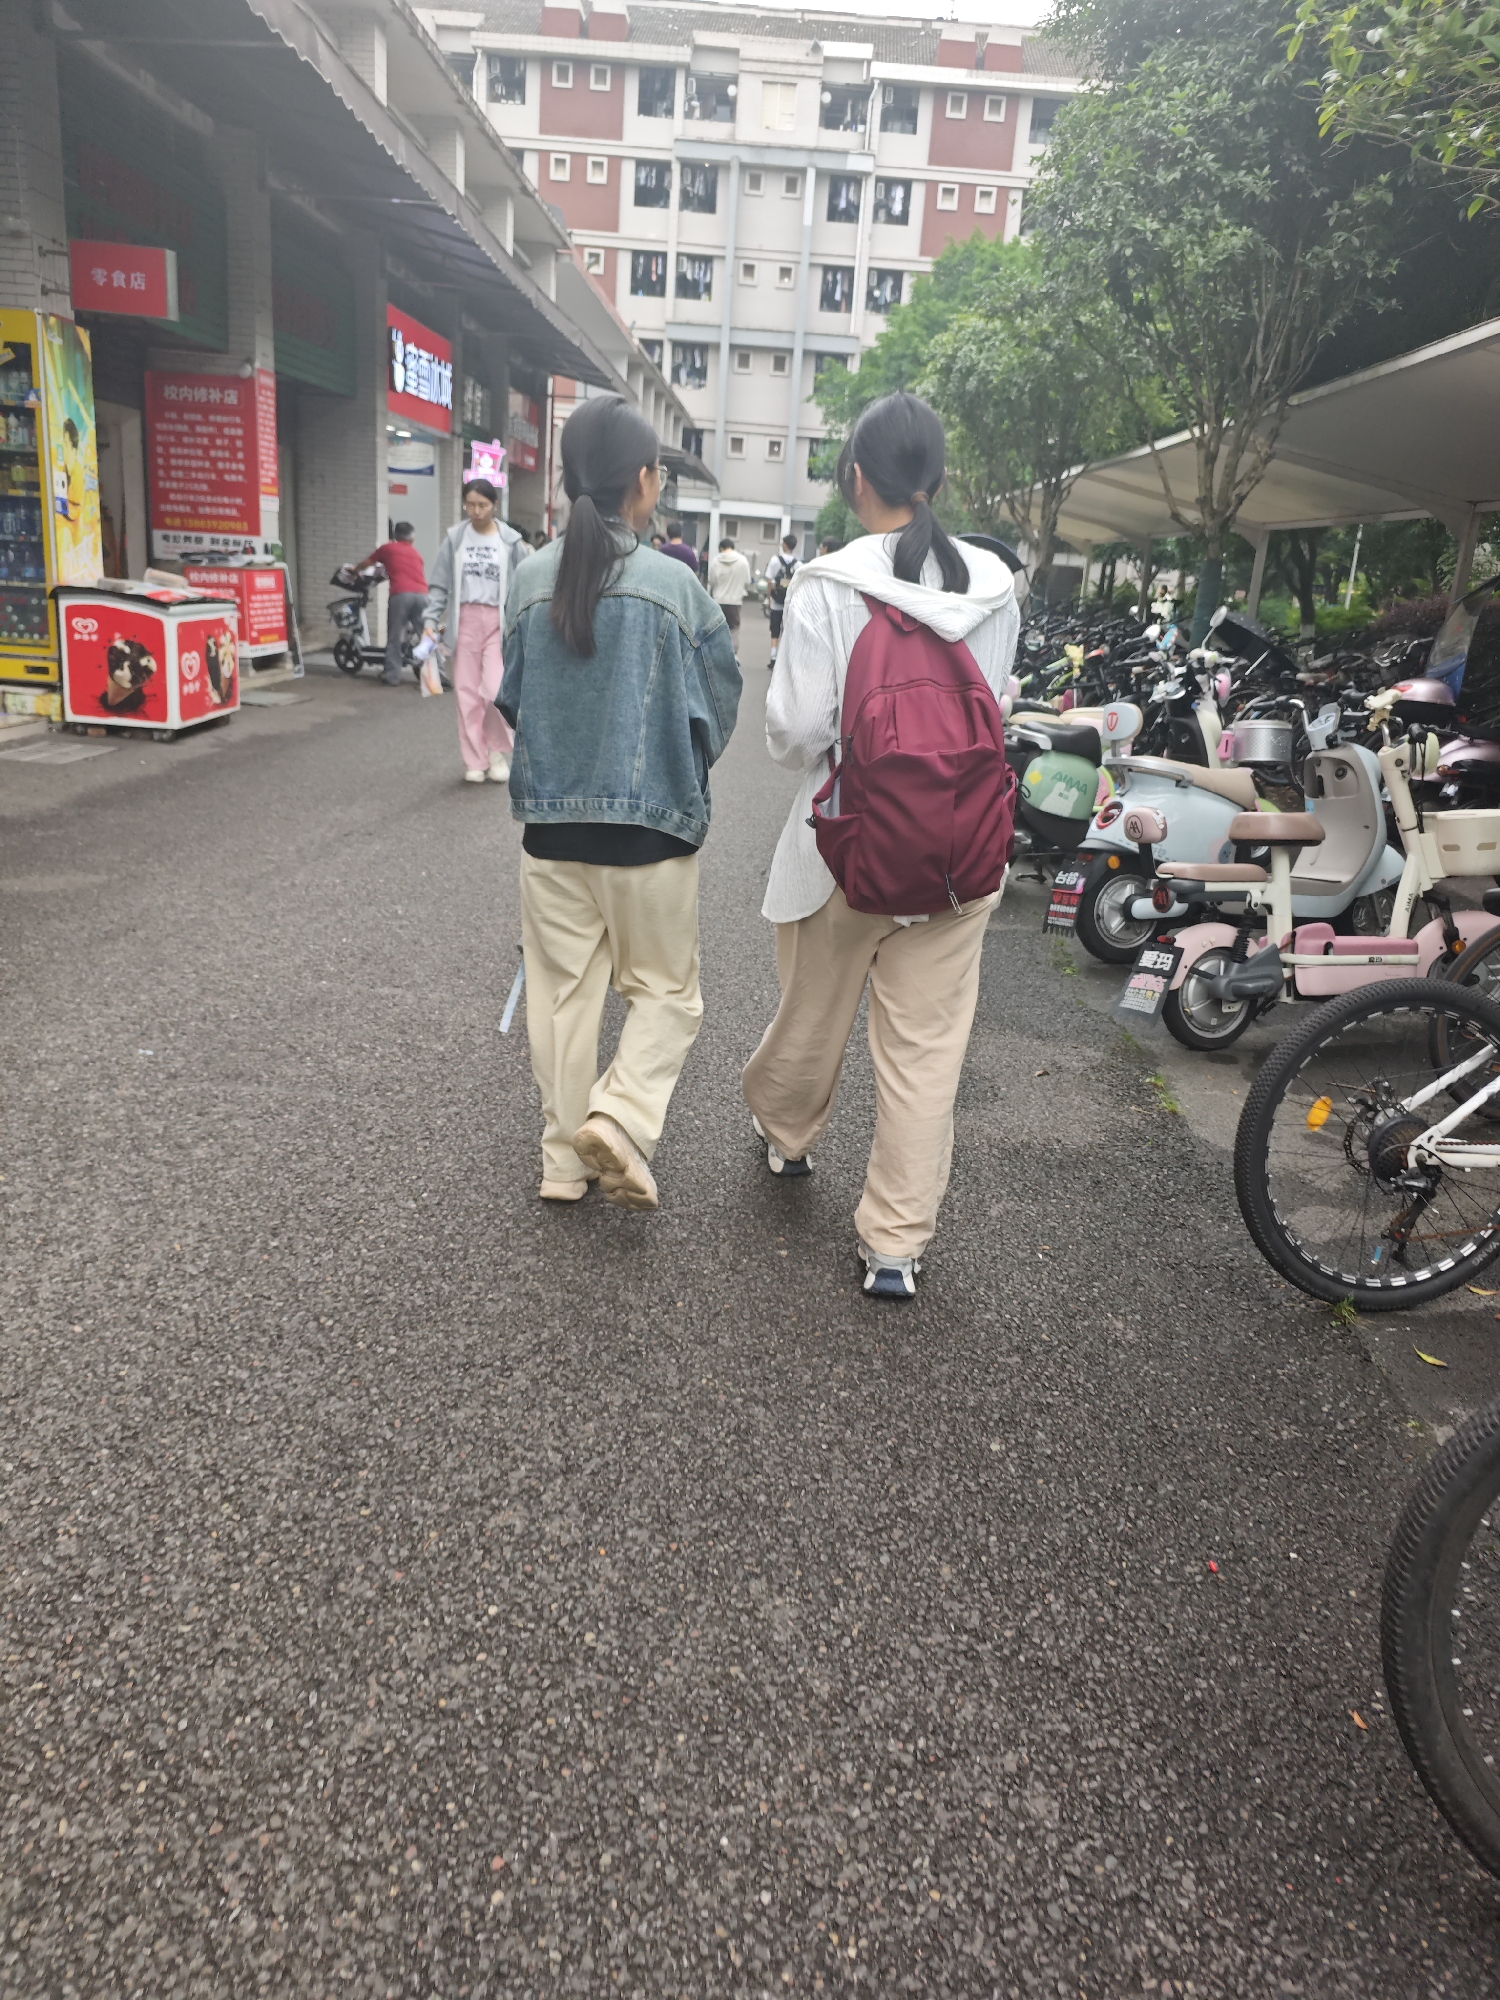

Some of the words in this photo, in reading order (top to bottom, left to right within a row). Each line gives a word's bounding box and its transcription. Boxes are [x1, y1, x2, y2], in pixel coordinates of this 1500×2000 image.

[91, 267, 146, 290] 零食店
[405, 342, 452, 410] 蜜雪冰城
[163, 384, 239, 405] 校内修补店
[1050, 771, 1088, 796] AIMA
[1138, 950, 1174, 971] 爱玛
